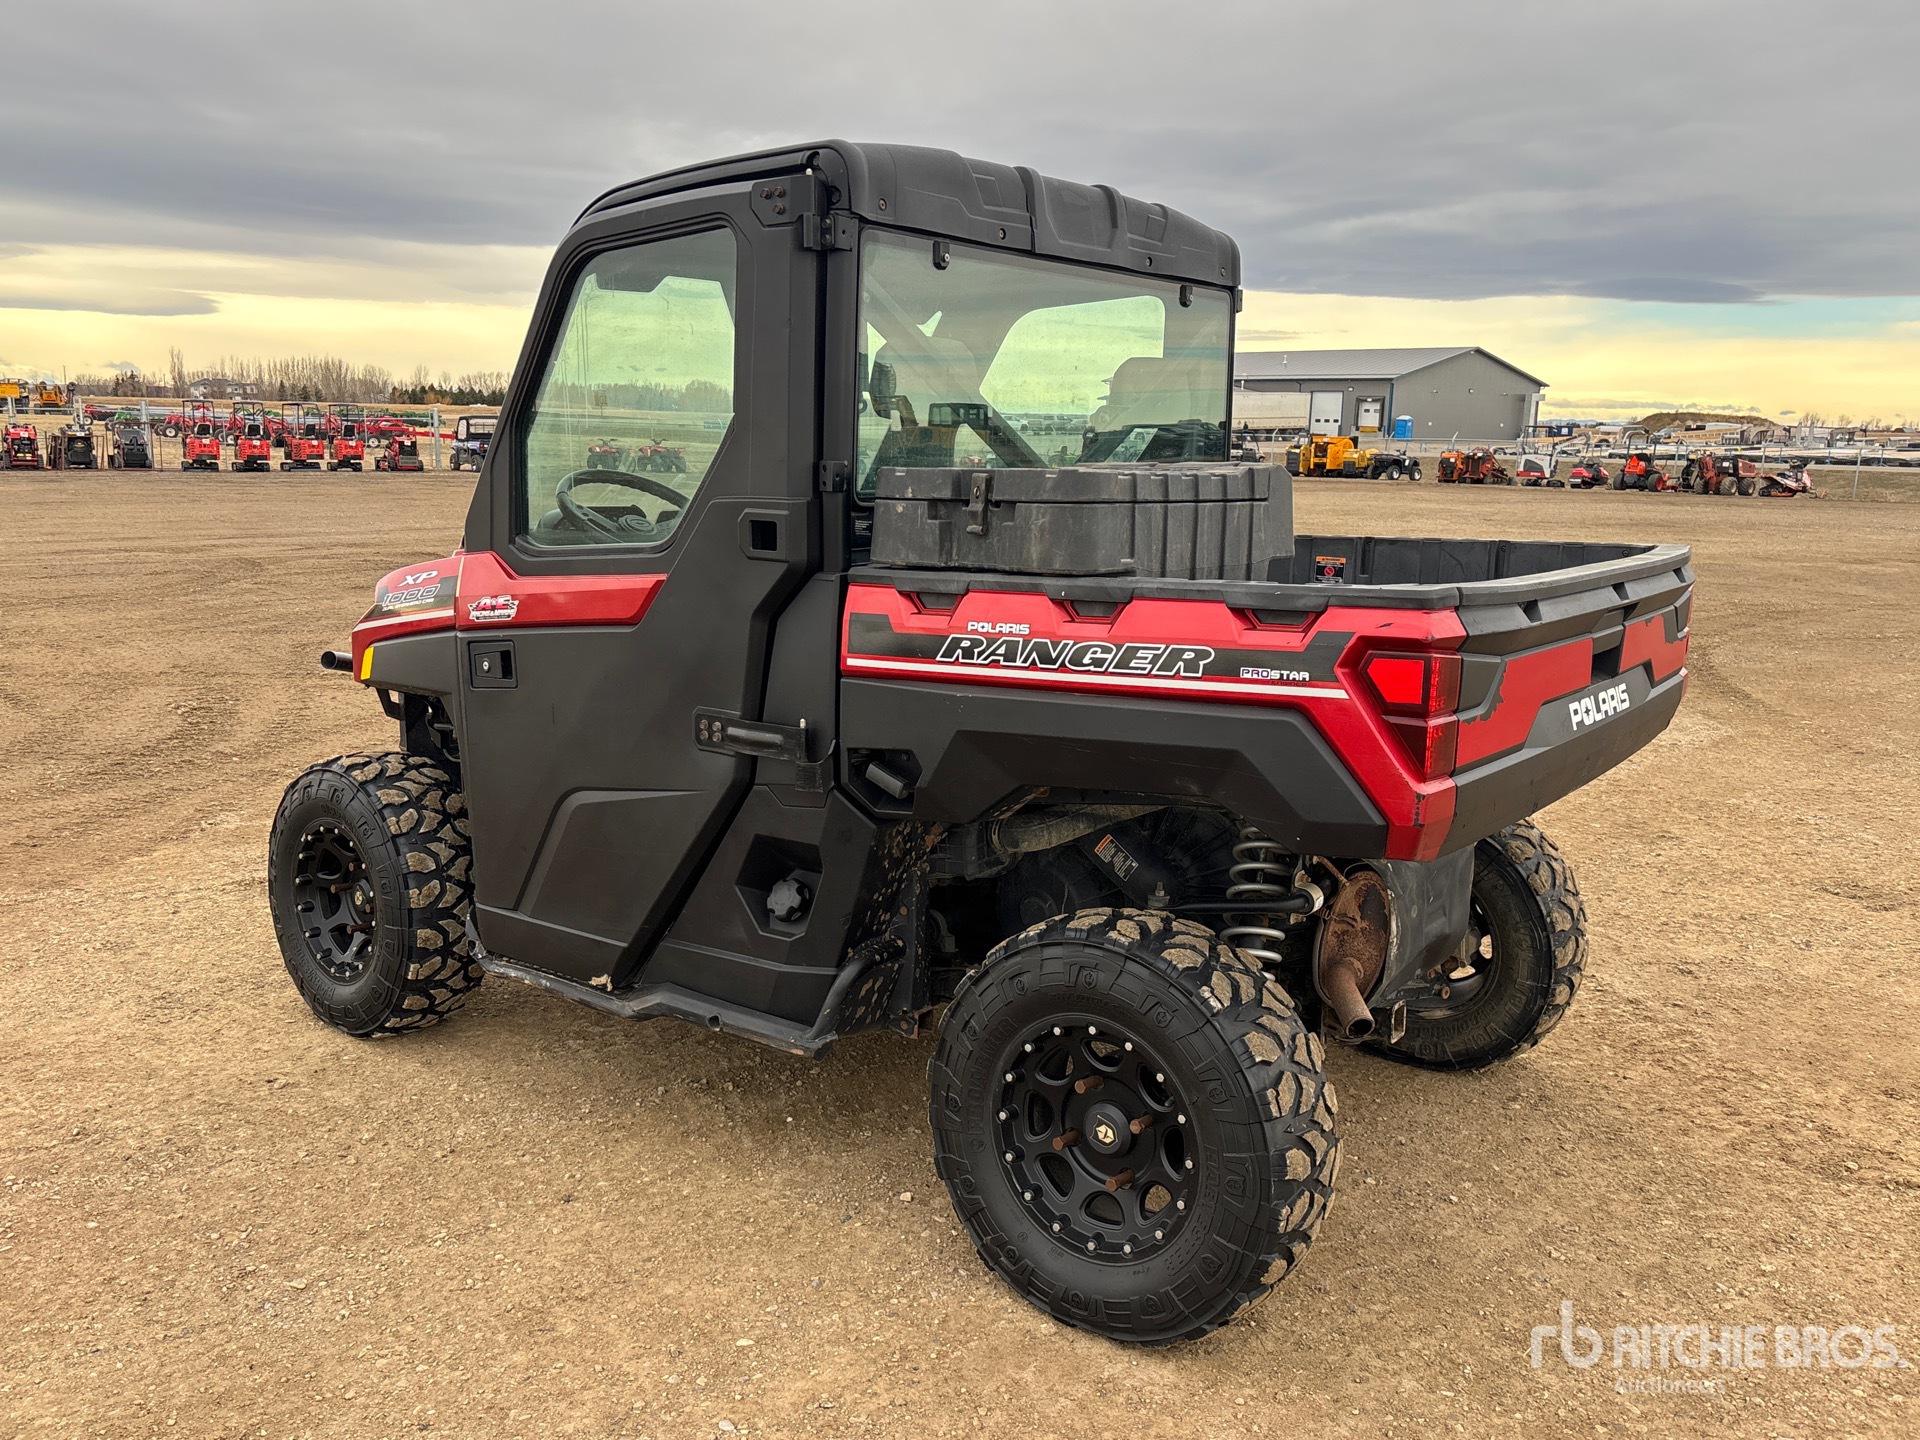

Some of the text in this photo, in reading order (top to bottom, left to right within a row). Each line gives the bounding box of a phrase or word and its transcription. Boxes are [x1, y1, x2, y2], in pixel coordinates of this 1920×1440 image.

[398, 570, 439, 587] XP
[382, 584, 441, 607] 1000
[967, 621, 1031, 635] POLARIS
[935, 634, 1216, 677] RANGER
[1240, 667, 1310, 682] PROSTAR
[1568, 682, 1631, 732] POLARIS
